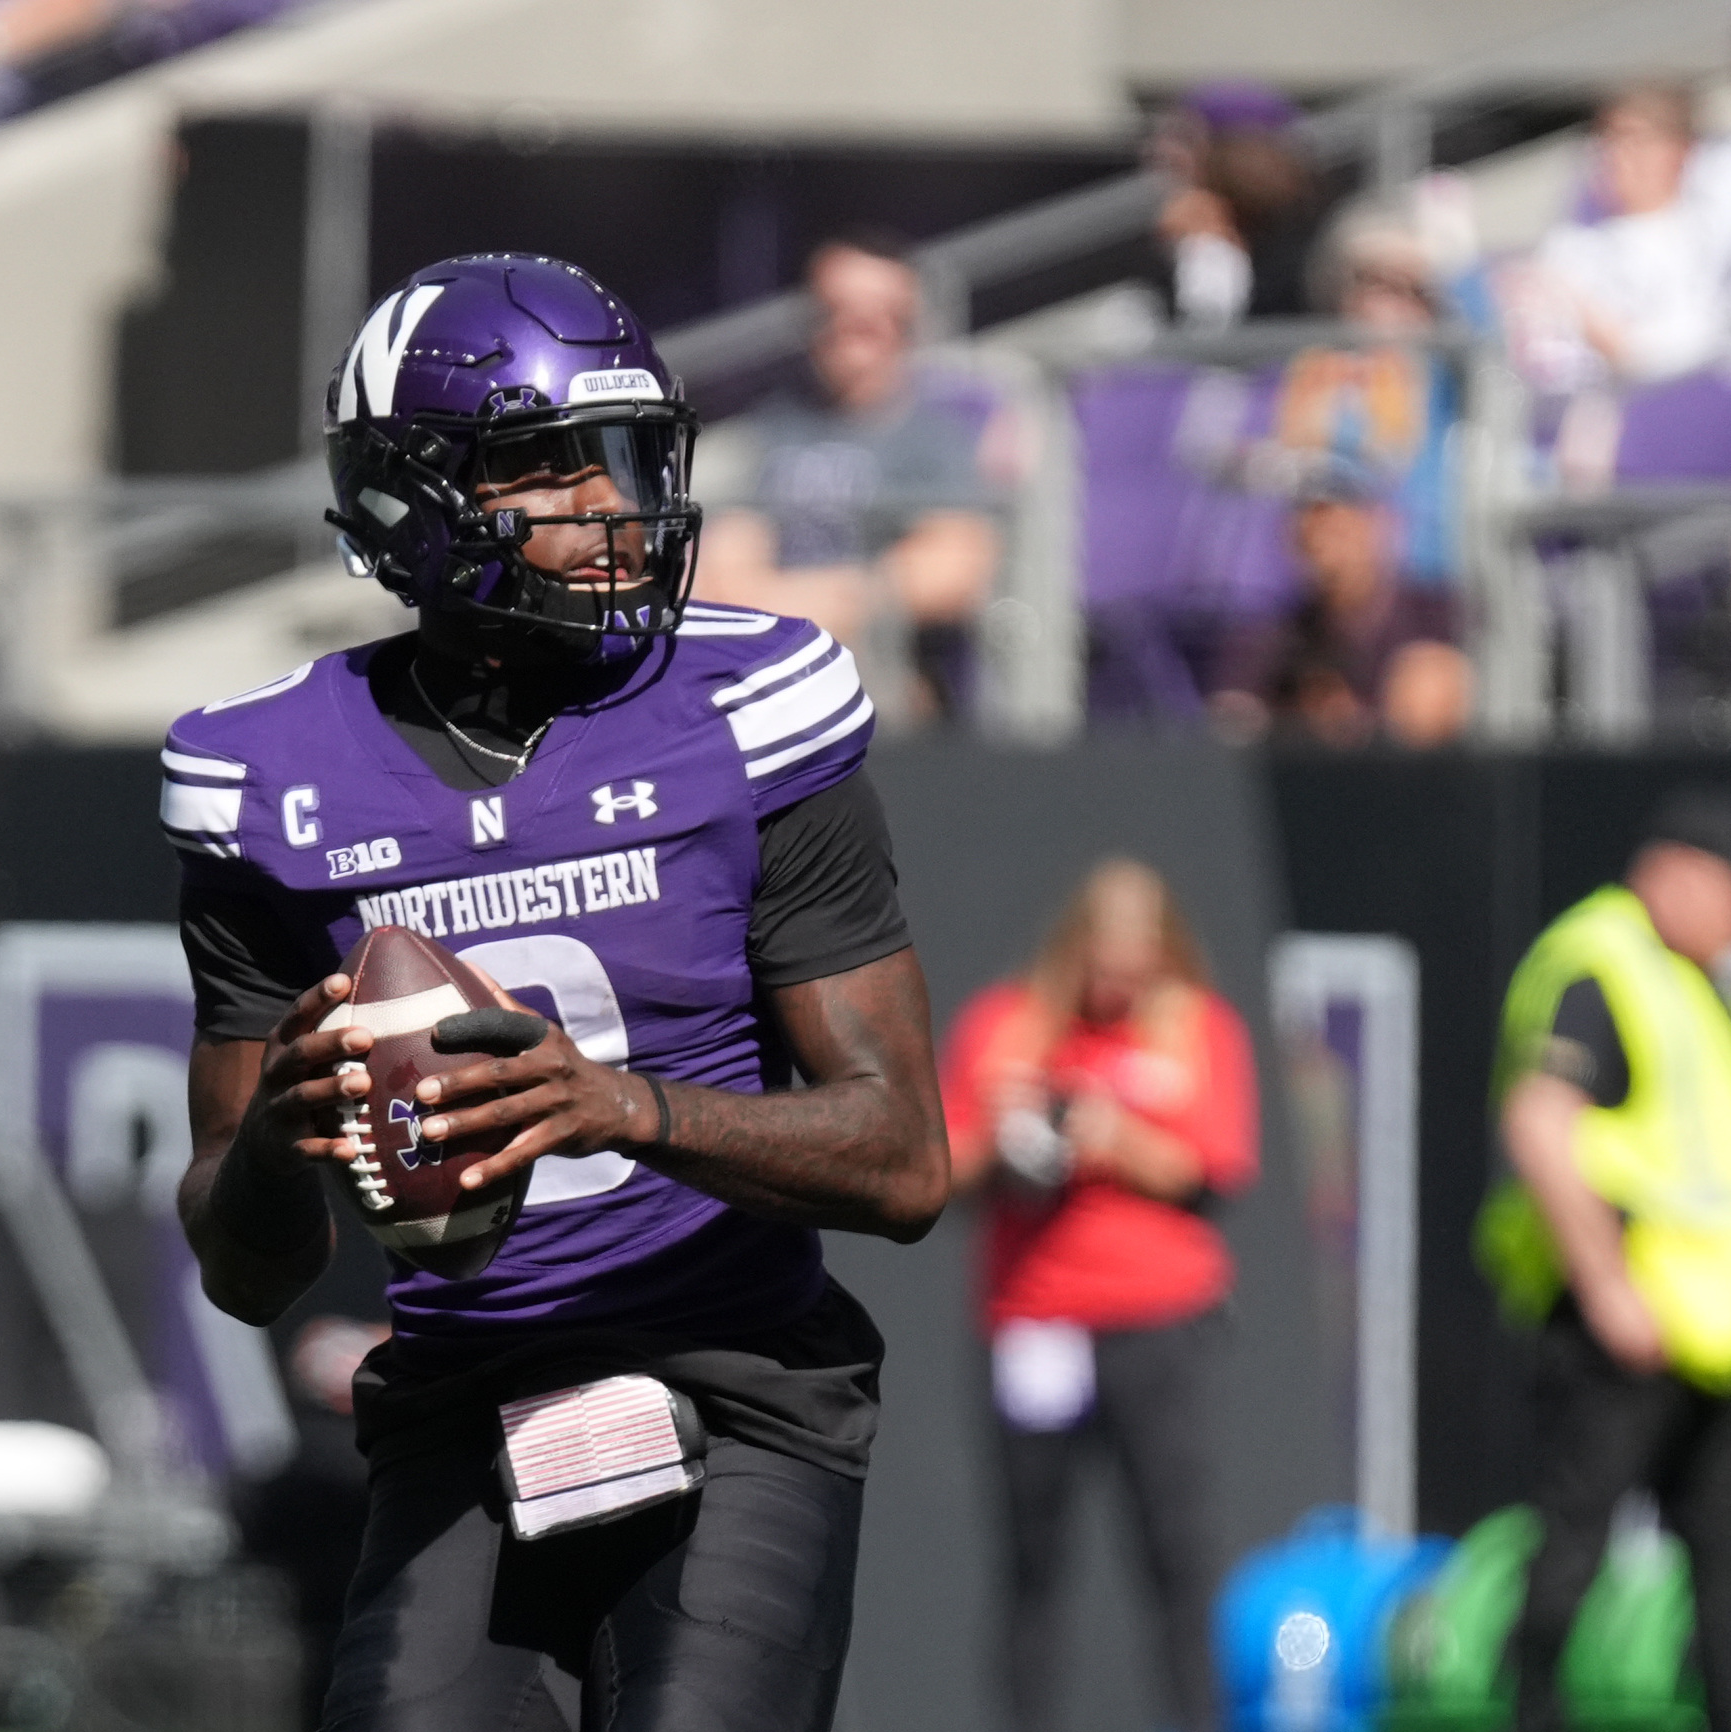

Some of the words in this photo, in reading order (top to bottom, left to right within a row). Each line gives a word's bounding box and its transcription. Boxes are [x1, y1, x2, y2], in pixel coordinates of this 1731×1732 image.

[338, 285, 445, 423] N
[583, 371, 650, 393] WILDCATS
[283, 786, 321, 848] C
[471, 796, 506, 846] N
[357, 847, 661, 938] NORTHWESTERN
